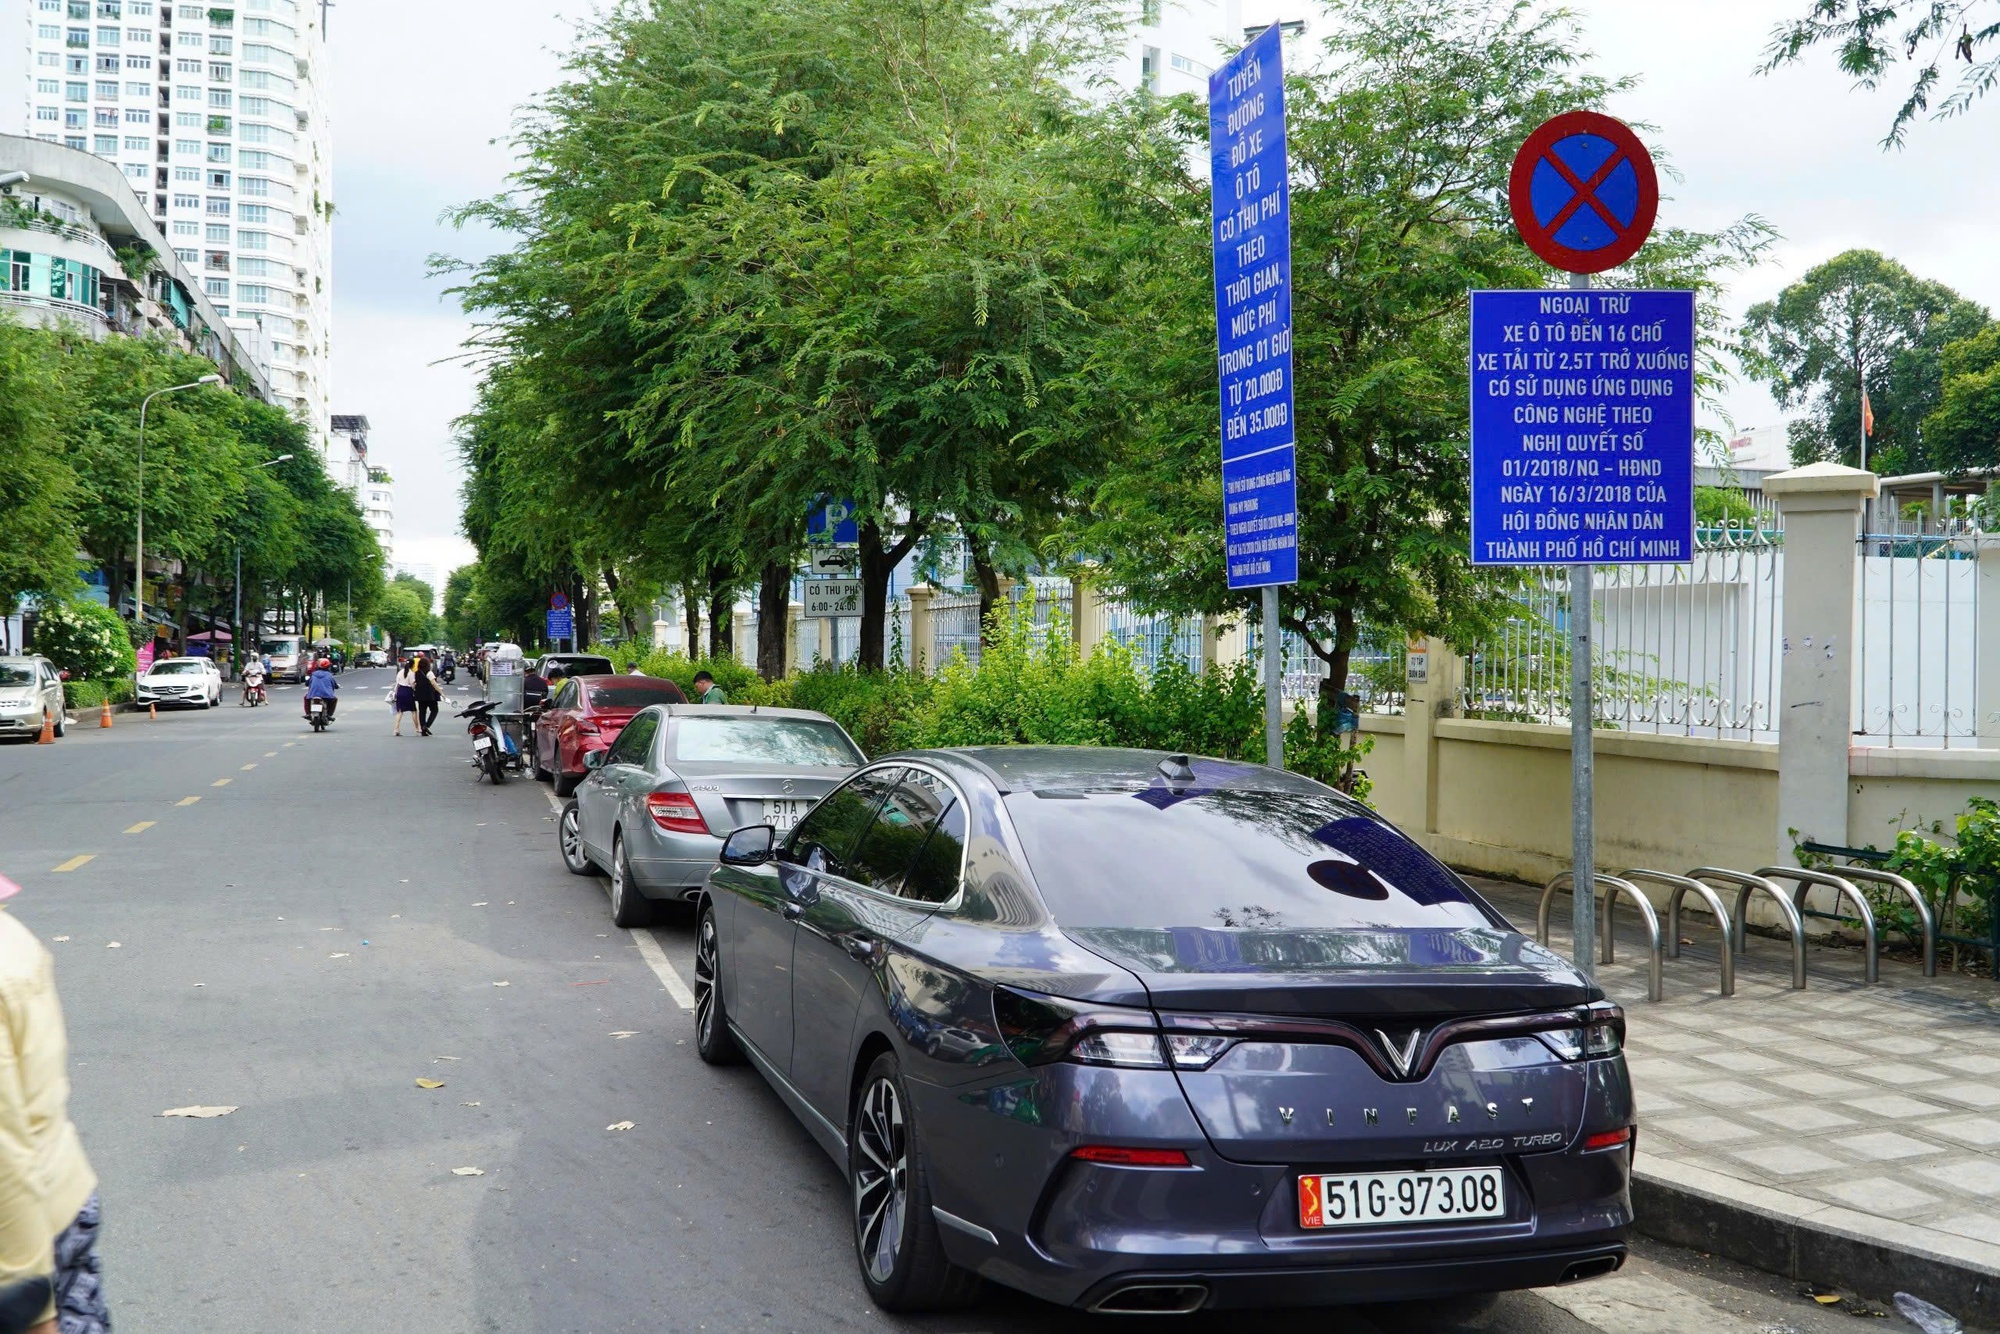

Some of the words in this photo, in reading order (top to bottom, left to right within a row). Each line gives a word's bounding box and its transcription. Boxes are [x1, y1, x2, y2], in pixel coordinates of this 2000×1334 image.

[1228, 52, 1261, 101] TUYẾN
[1228, 92, 1264, 136] ĐƯỜNG
[1232, 132, 1246, 169] ĐỖ
[1248, 128, 1264, 159] XE
[1235, 172, 1244, 200] Ô
[1246, 163, 1261, 194] TÔ
[1220, 208, 1235, 243] CÓ
[1236, 201, 1259, 231] THU
[1261, 181, 1281, 220] PHÍ
[1236, 234, 1265, 268] THEO
[1226, 271, 1251, 307] THỜI
[1253, 262, 1283, 290] GIAN,
[1231, 306, 1256, 339] MỨC
[1258, 291, 1277, 330] PHÍ
[1540, 296, 1589, 318] NGOẠI
[1599, 296, 1632, 315] TRỪ
[1503, 325, 1524, 343] XE
[1529, 321, 1540, 343] Ô
[1545, 321, 1565, 343] TÔ
[1570, 318, 1602, 343] ĐẾN
[1608, 324, 1626, 342] 16
[1631, 319, 1667, 342] CHỖ
[1219, 344, 1253, 377] TRONG
[1256, 338, 1268, 362] 01
[1272, 323, 1291, 357] GIỜ
[1477, 353, 1498, 371] XE
[1503, 348, 1528, 371] TẢI
[1533, 348, 1555, 371] TỪ
[1559, 352, 1594, 371] 2,5T
[1600, 348, 1631, 370] TRỞ
[1635, 346, 1689, 370] XUỐNG
[1228, 377, 1243, 407] TỪ
[1245, 368, 1284, 400] 20.000Đ
[1488, 375, 1510, 397] CÓ
[1515, 374, 1538, 397] SỬ
[1543, 378, 1587, 400] DỤNG
[1591, 374, 1625, 397] ỨNG
[1630, 378, 1673, 400] DỤNG
[1226, 407, 1248, 441] ĐẾN
[1249, 402, 1288, 432] 35.000Đ
[1513, 403, 1558, 424] CÔNG
[1563, 403, 1607, 428] NGHỆ
[1612, 406, 1653, 424] THEO
[1522, 434, 1561, 455] NGHỊ
[1566, 428, 1618, 452] QUYẾT
[1622, 428, 1647, 452] SỐ
[1502, 459, 1599, 478] 01/2018/NQ
[1618, 459, 1662, 476] HĐND
[1501, 481, 1544, 503] NGÀY
[1550, 484, 1631, 504] 16/3/2018
[1636, 480, 1667, 503] CỦA
[825, 504, 848, 533] P
[1502, 510, 1530, 534] HỘI
[1535, 507, 1580, 531] ĐỒNG
[1584, 509, 1628, 531] NHÂN
[1632, 509, 1663, 530] DÂN
[1486, 537, 1540, 559] THÀNH
[1545, 535, 1580, 558] PHỐ
[1582, 533, 1604, 558] HỒ
[1609, 536, 1635, 557] CHÍ
[1639, 540, 1680, 558] MINH
[809, 583, 820, 595] CÓ
[825, 585, 841, 595] THU
[773, 800, 798, 815] 51A
[1279, 1097, 1534, 1127] VINFAST
[1423, 1141, 1458, 1153] LUX
[1513, 1132, 1562, 1148] TURBO
[1326, 1173, 1498, 1220] 51G-973.08
[1303, 1215, 1321, 1226] VIE
